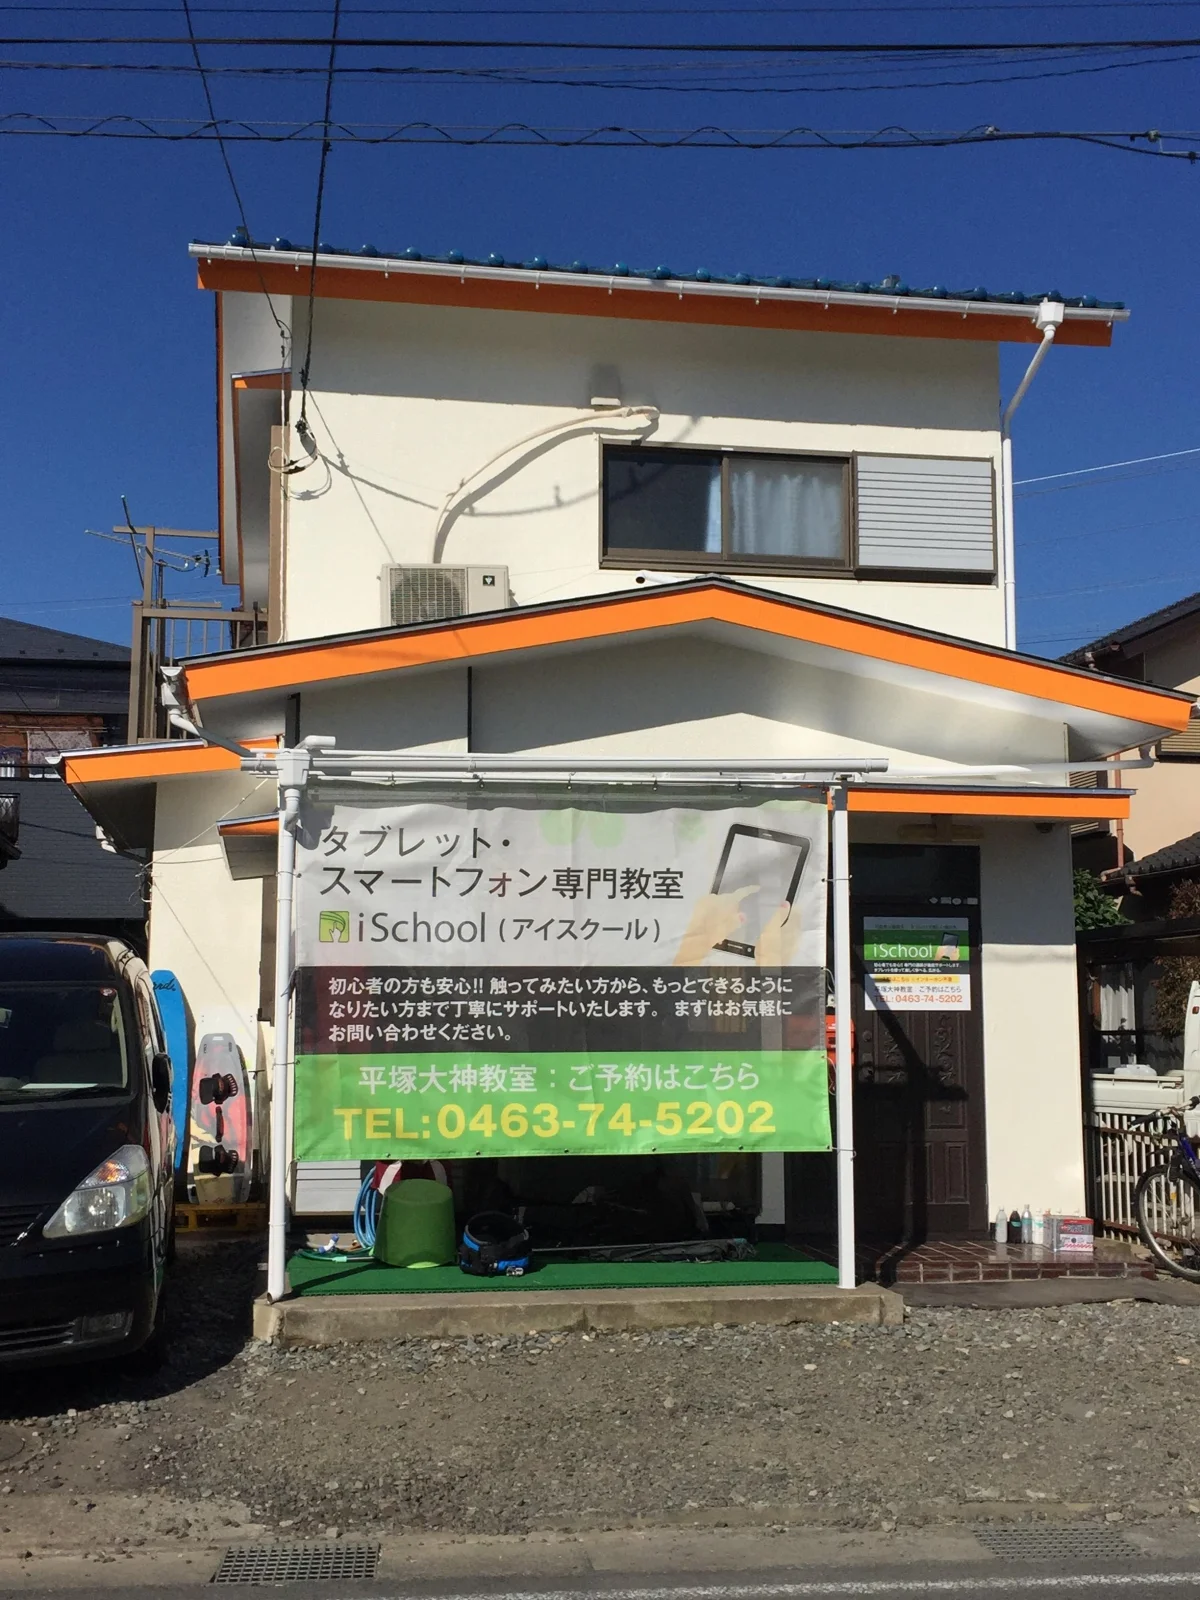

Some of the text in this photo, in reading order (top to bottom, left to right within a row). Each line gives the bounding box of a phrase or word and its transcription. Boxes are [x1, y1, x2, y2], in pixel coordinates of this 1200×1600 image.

[318, 824, 511, 859] タブレット・
[319, 866, 685, 901] スマートフォン専門教室
[357, 911, 486, 943] iSchool
[873, 943, 933, 958] iSchool
[489, 976, 793, 996] 触ってみたい方から、もっとできるように
[328, 999, 793, 1019] なりたい方まで丁寧にサポートいたします。 まずはお気軽に
[328, 1023, 512, 1043] お問い合わせください。
[334, 1101, 777, 1140] TEL:0463-74-5202
